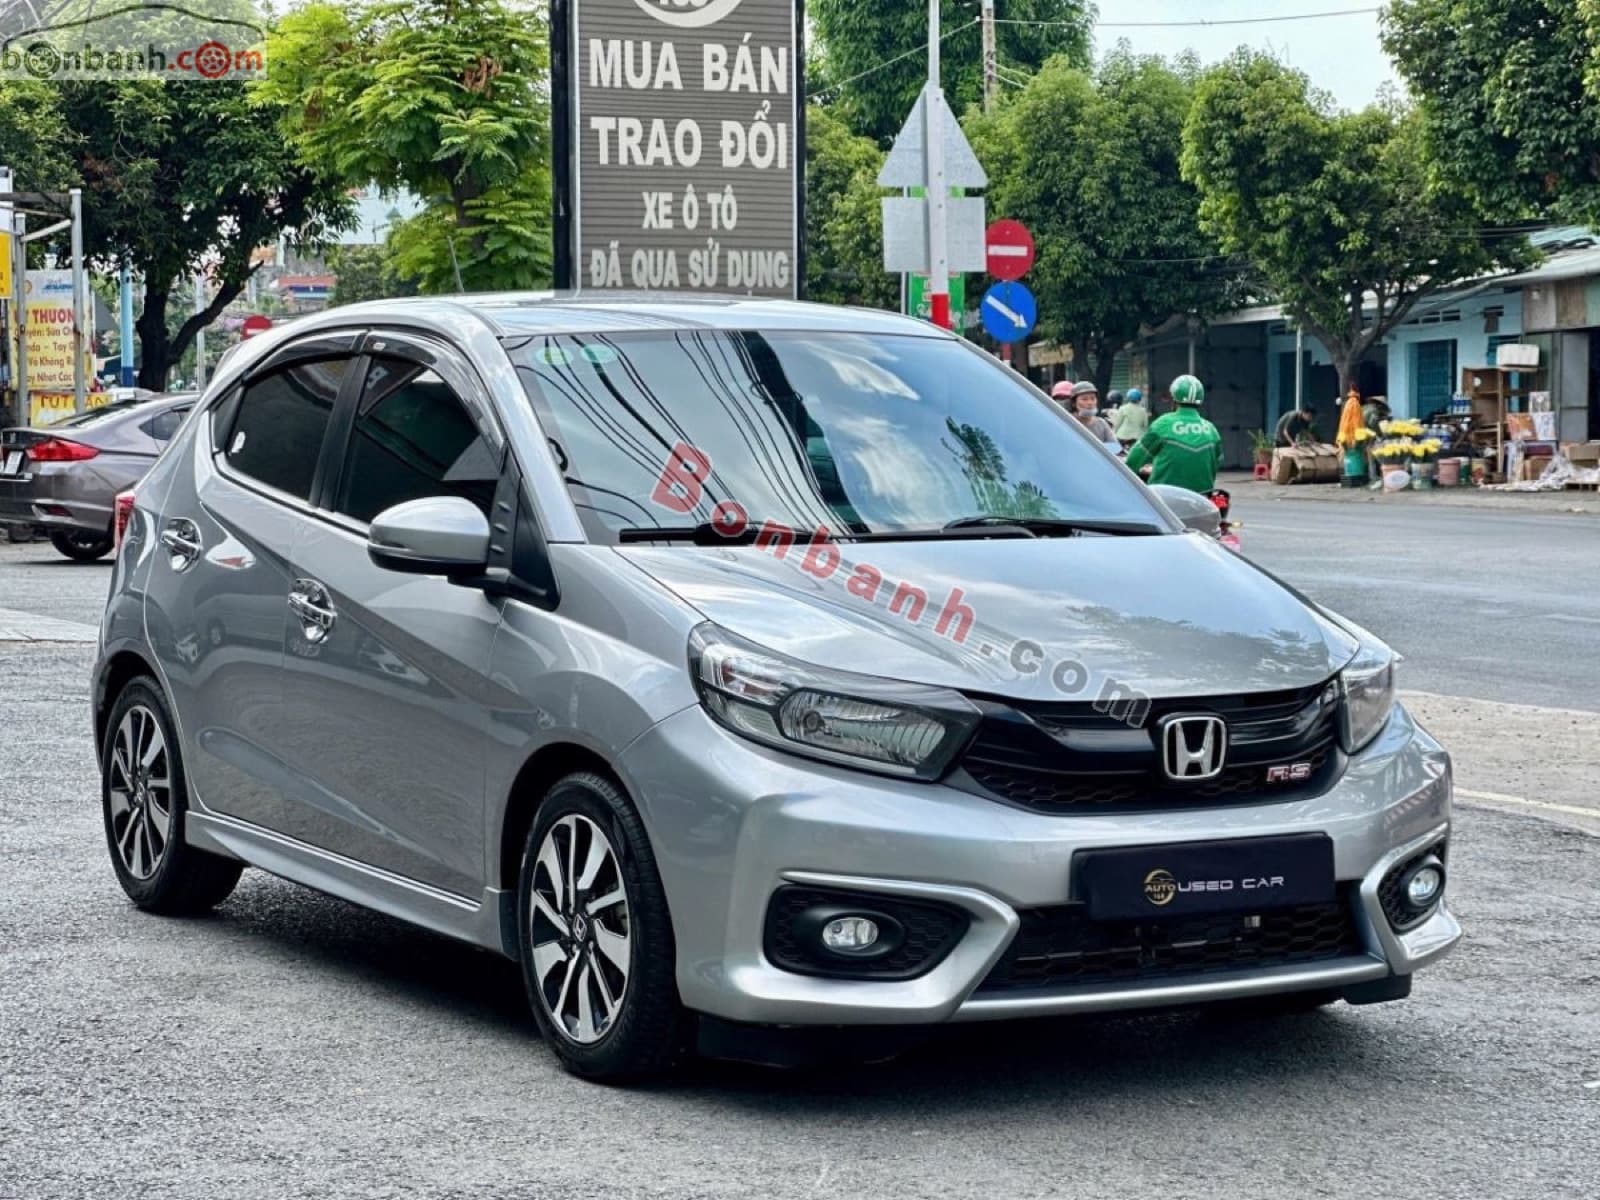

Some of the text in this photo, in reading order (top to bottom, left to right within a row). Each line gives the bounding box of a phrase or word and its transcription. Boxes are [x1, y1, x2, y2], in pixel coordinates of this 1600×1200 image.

[589, 32, 788, 94] MUA BÁN
[590, 100, 788, 169] TRAO ĐỔI
[642, 183, 738, 230] XE Ô TÔ
[590, 236, 789, 297] ĐÃ QUA SỬ DỤNG
[1266, 762, 1311, 782] RS
[1177, 876, 1285, 893] USED CAR
